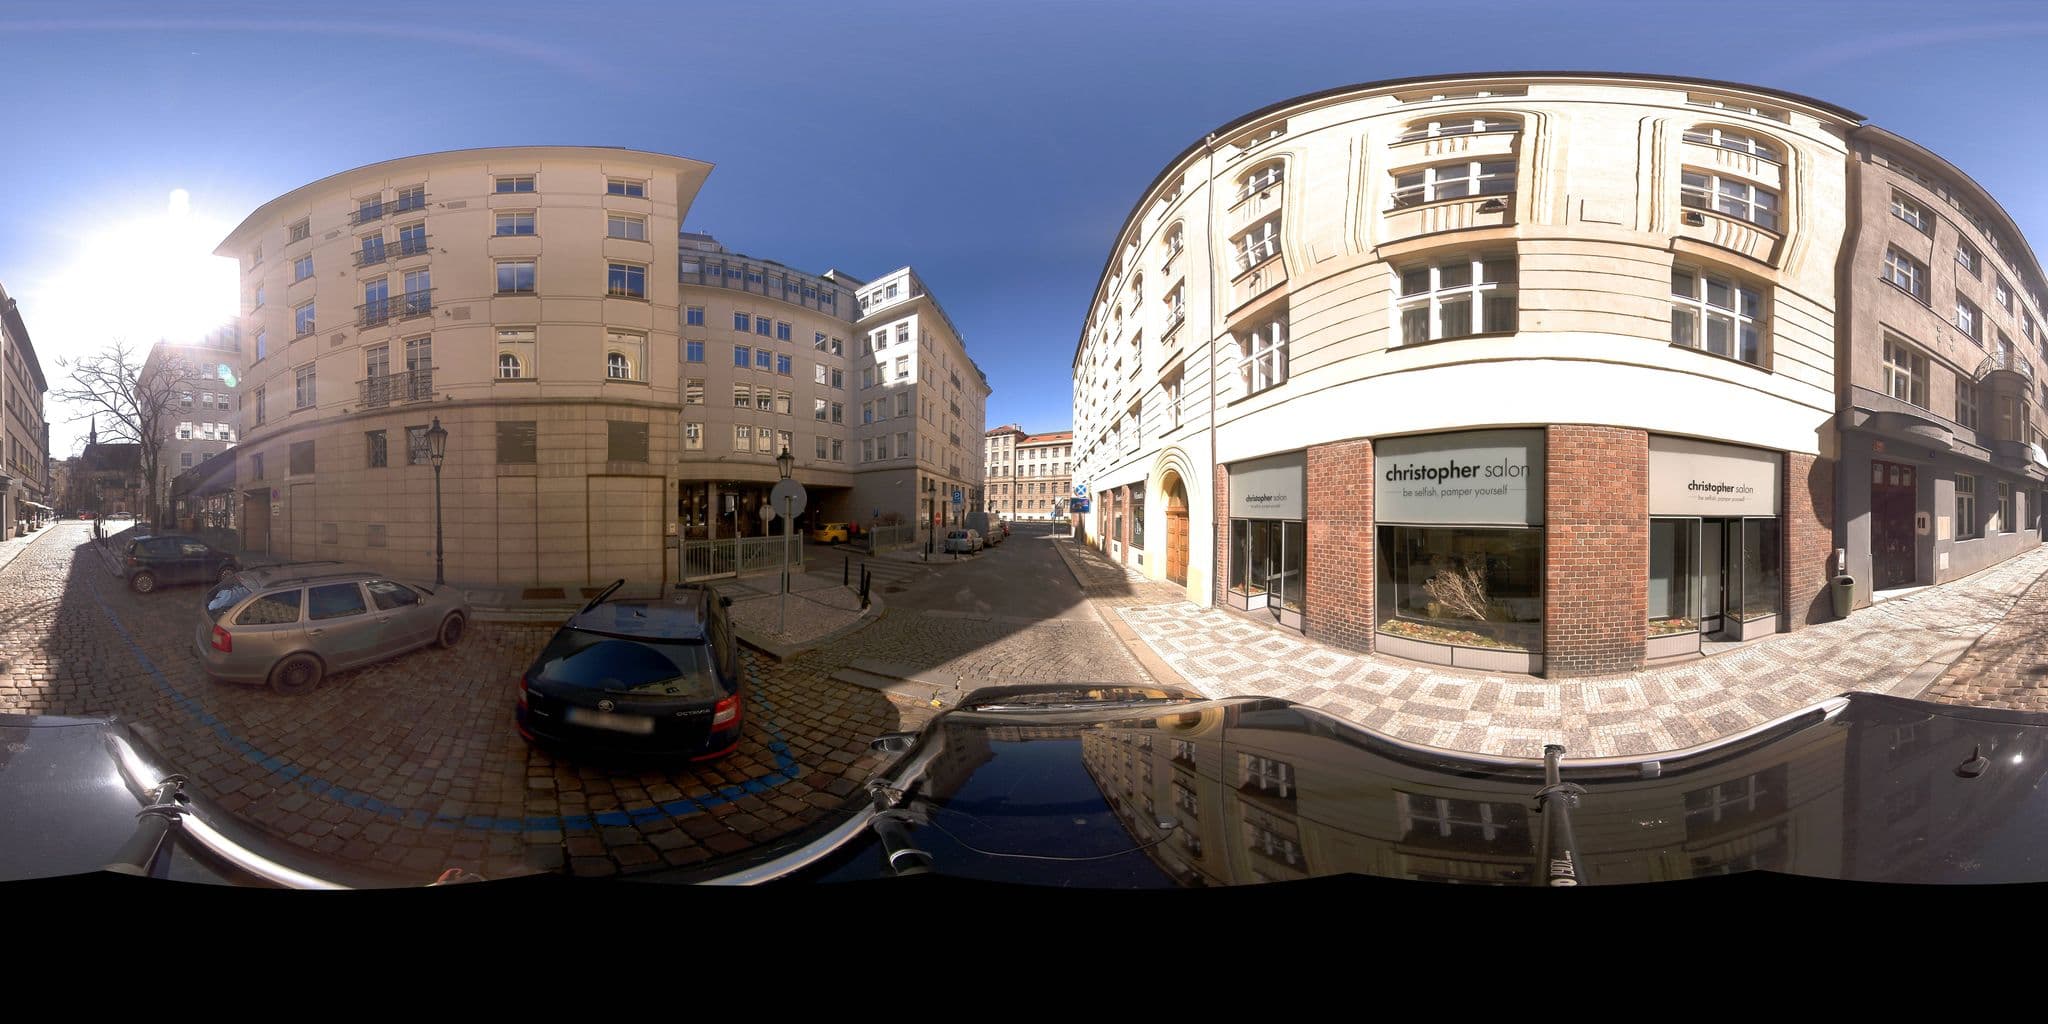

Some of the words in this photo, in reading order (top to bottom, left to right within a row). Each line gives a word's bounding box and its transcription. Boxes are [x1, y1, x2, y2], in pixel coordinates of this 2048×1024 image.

[1386, 459, 1481, 484] christopher
[1485, 457, 1530, 478] salon
[1402, 487, 1411, 497] be
[1441, 487, 1472, 498] pamper
[1475, 485, 1508, 497] yourself
[1688, 480, 1734, 494] christopher
[1735, 484, 1754, 494] salon
